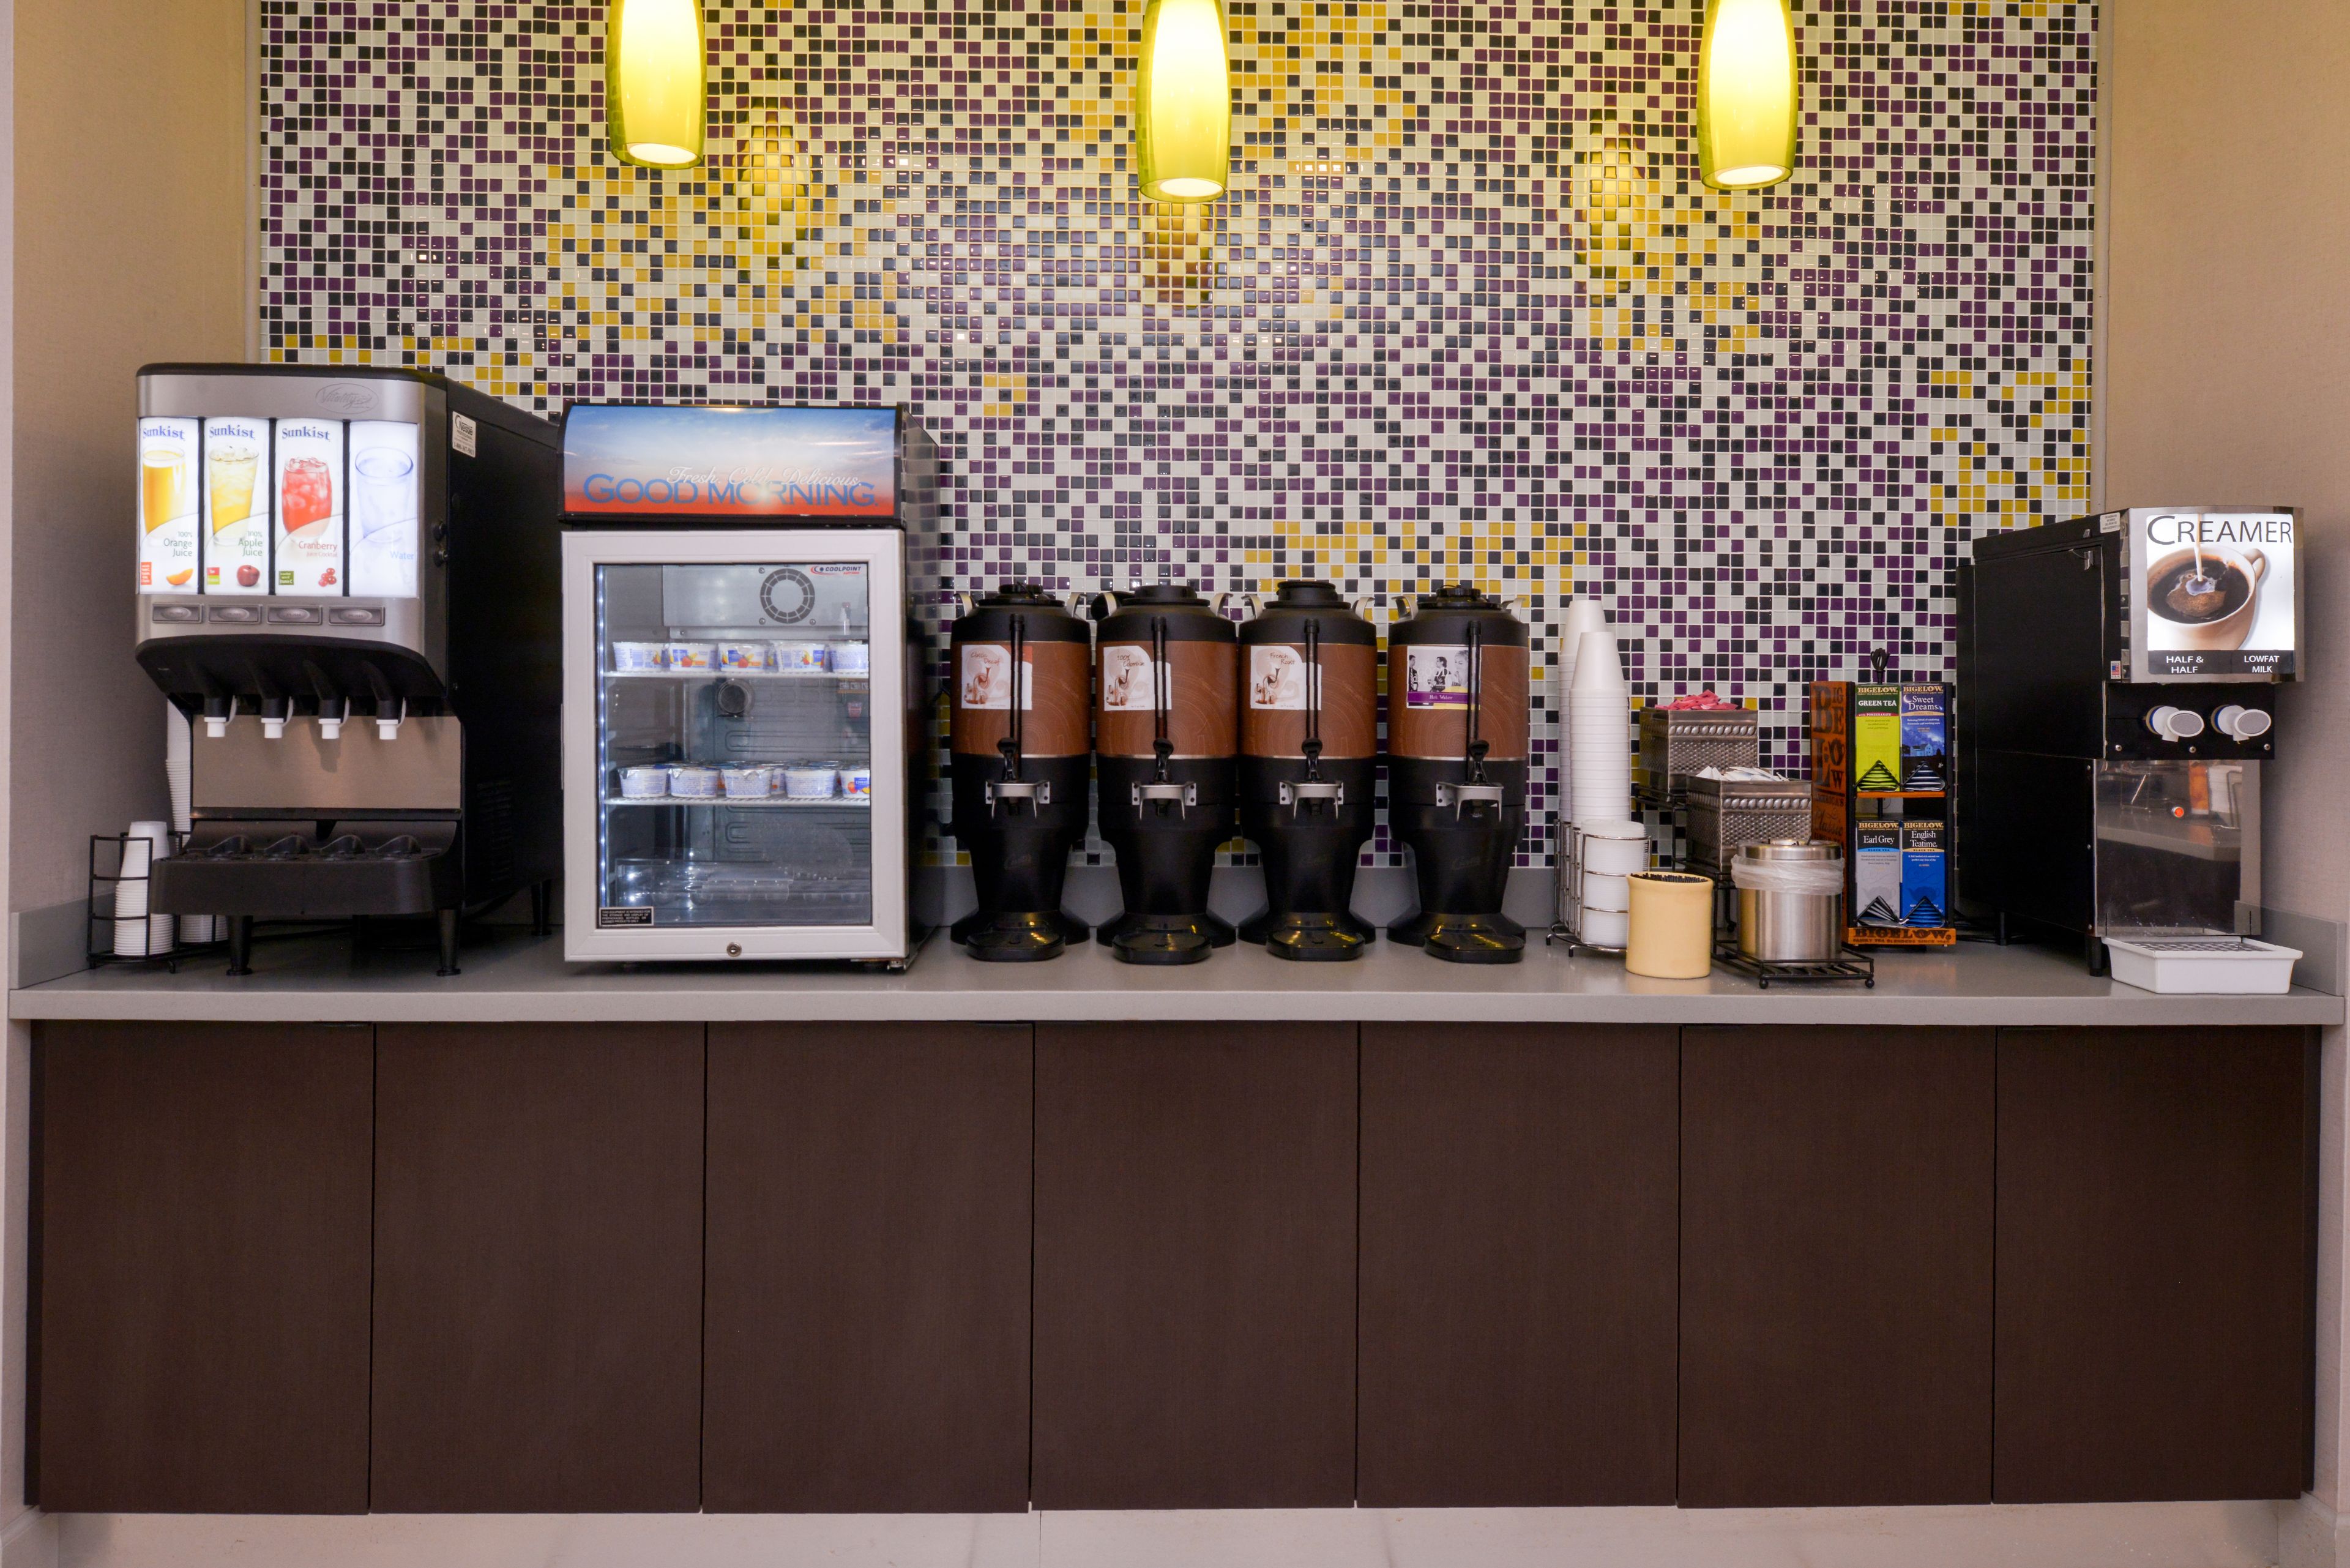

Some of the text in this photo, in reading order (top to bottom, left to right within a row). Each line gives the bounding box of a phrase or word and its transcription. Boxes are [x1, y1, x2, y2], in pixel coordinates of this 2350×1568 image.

[143, 426, 185, 439] Sunkist
[209, 425, 255, 439] Sunkist
[282, 426, 330, 440] Sunkist
[666, 466, 721, 484] Fresh.
[781, 466, 862, 486] Delicious.
[583, 473, 698, 504] GOOD
[2147, 515, 2292, 545] CREAMER
[163, 539, 192, 549] Orange
[238, 538, 263, 549] Apple
[299, 541, 338, 551] Cranberry
[242, 548, 263, 557] Juice
[1878, 835, 1895, 844] Grey
[1911, 831, 1936, 840] English
